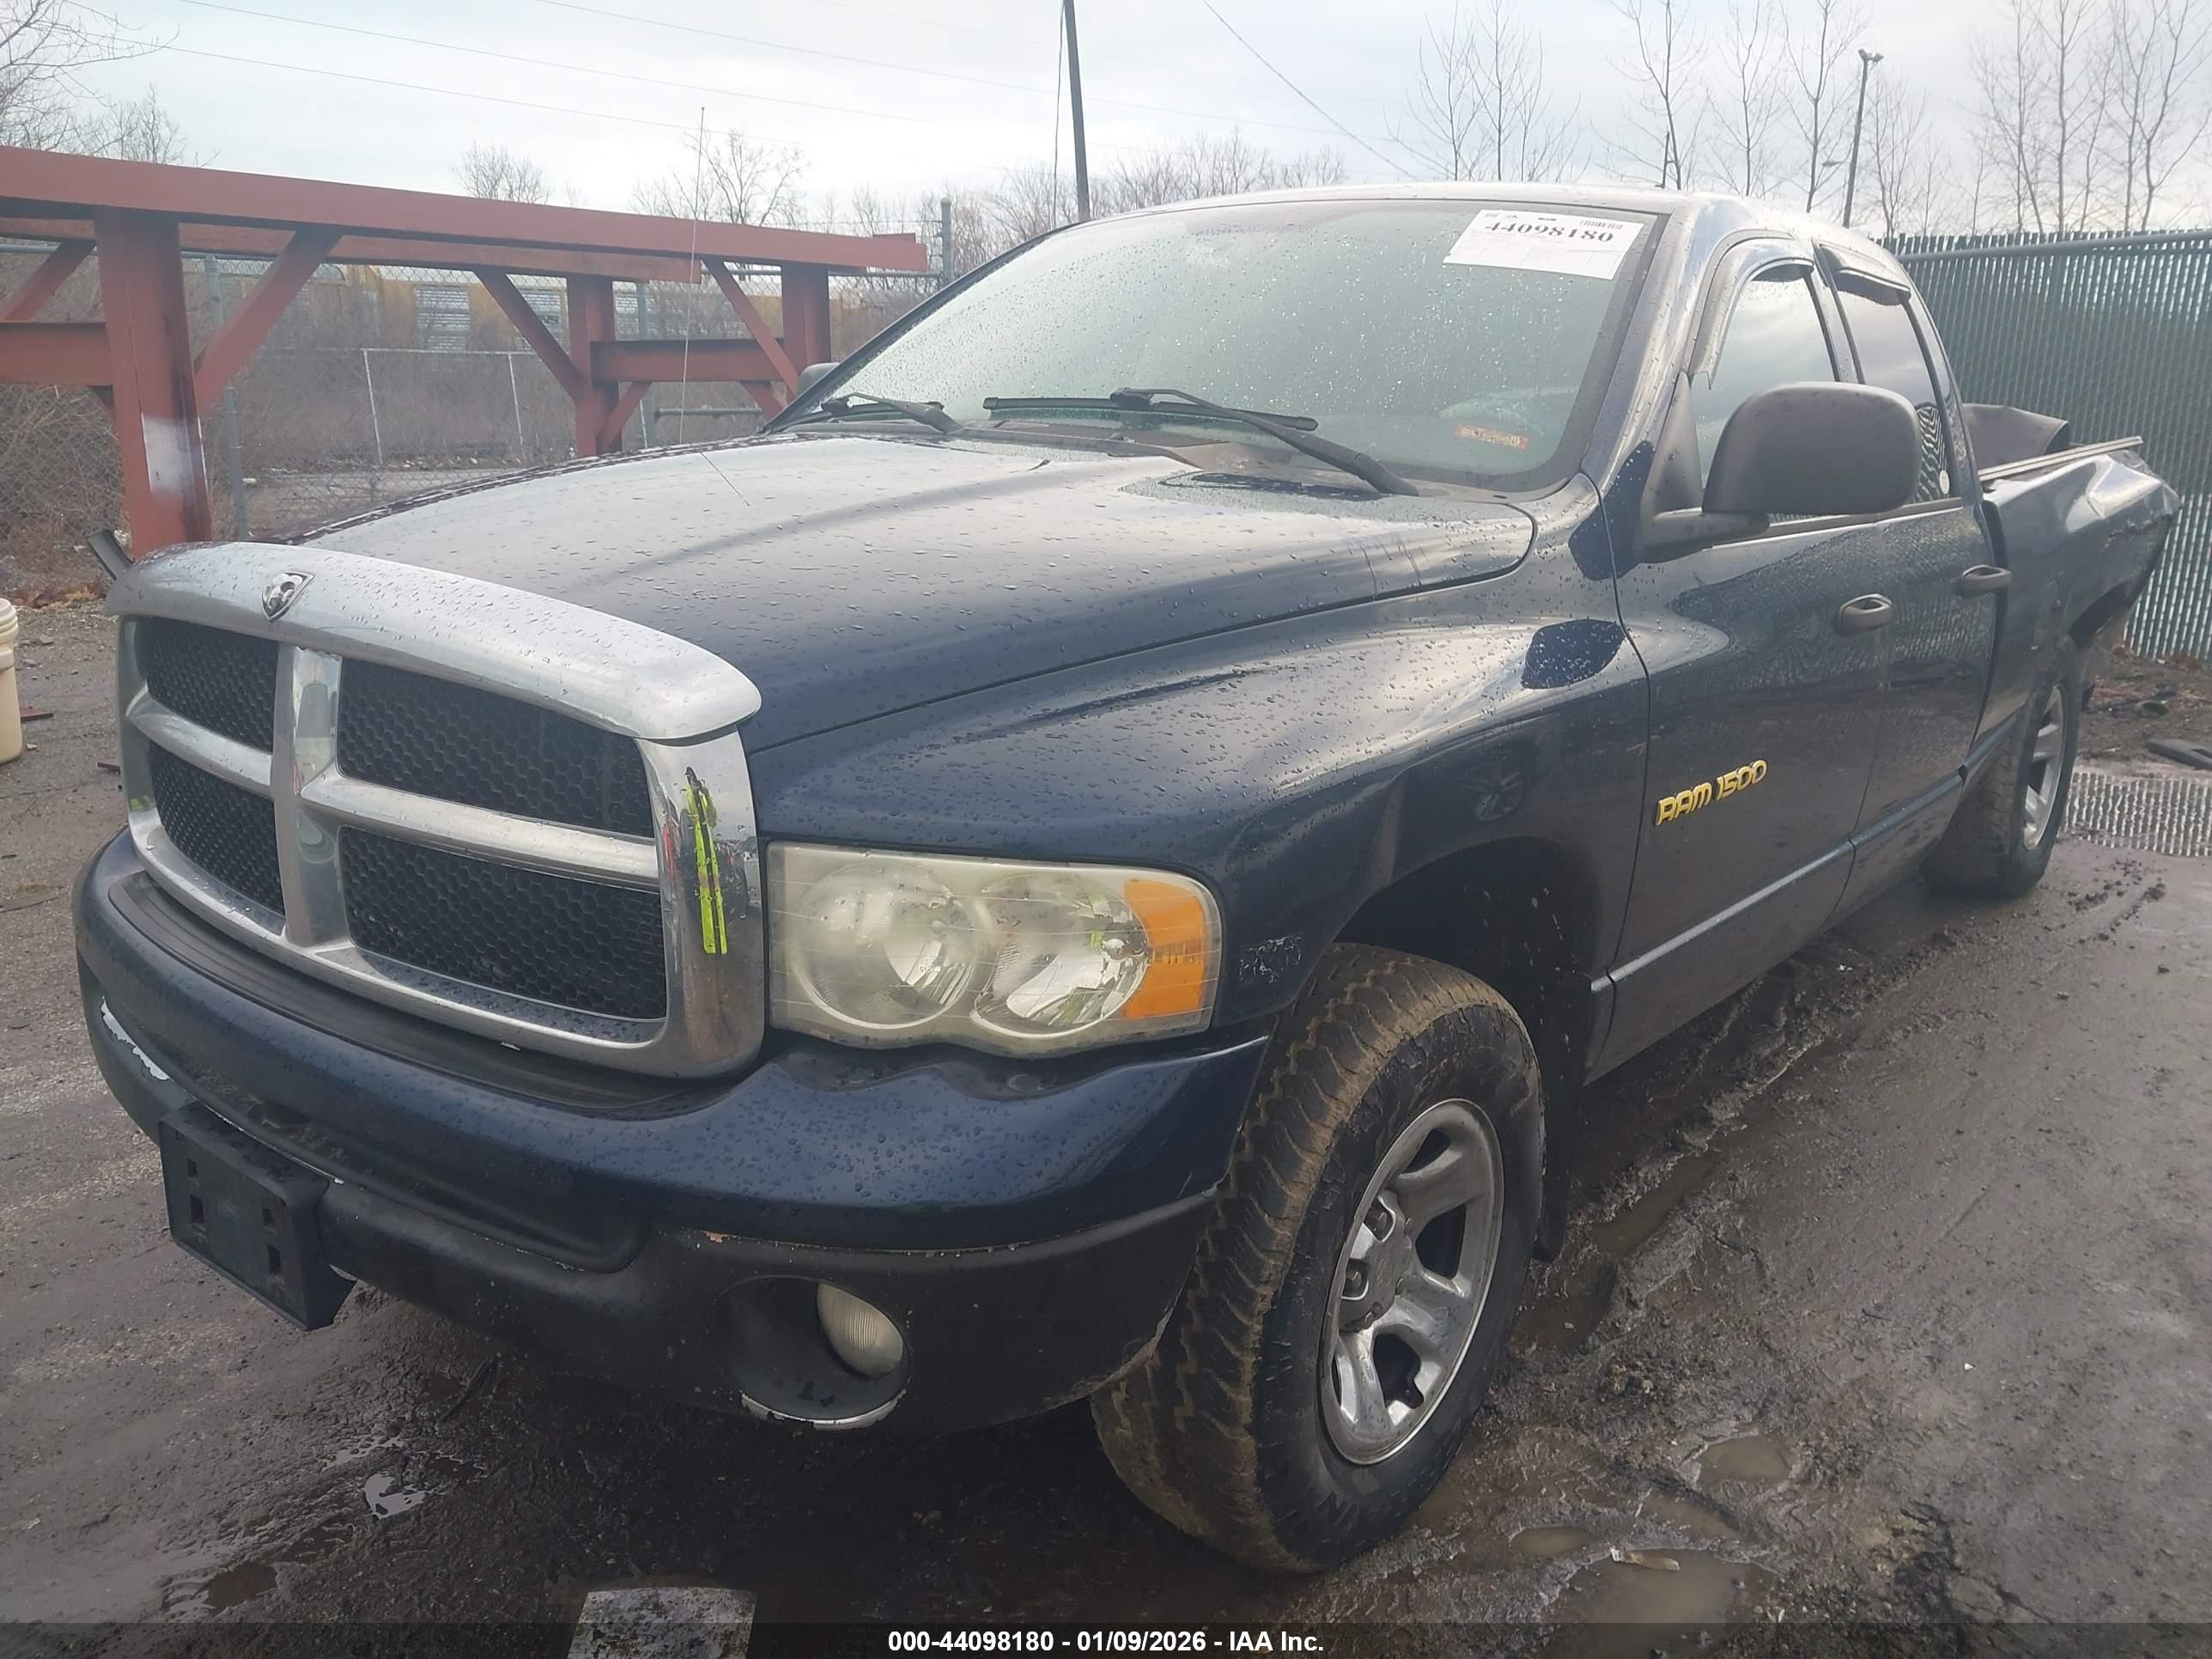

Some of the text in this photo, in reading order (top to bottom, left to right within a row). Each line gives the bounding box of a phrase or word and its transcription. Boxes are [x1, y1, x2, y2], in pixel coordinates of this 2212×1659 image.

[1484, 221, 1614, 243] 44098180
[1655, 759, 1768, 826] RAM 1500
